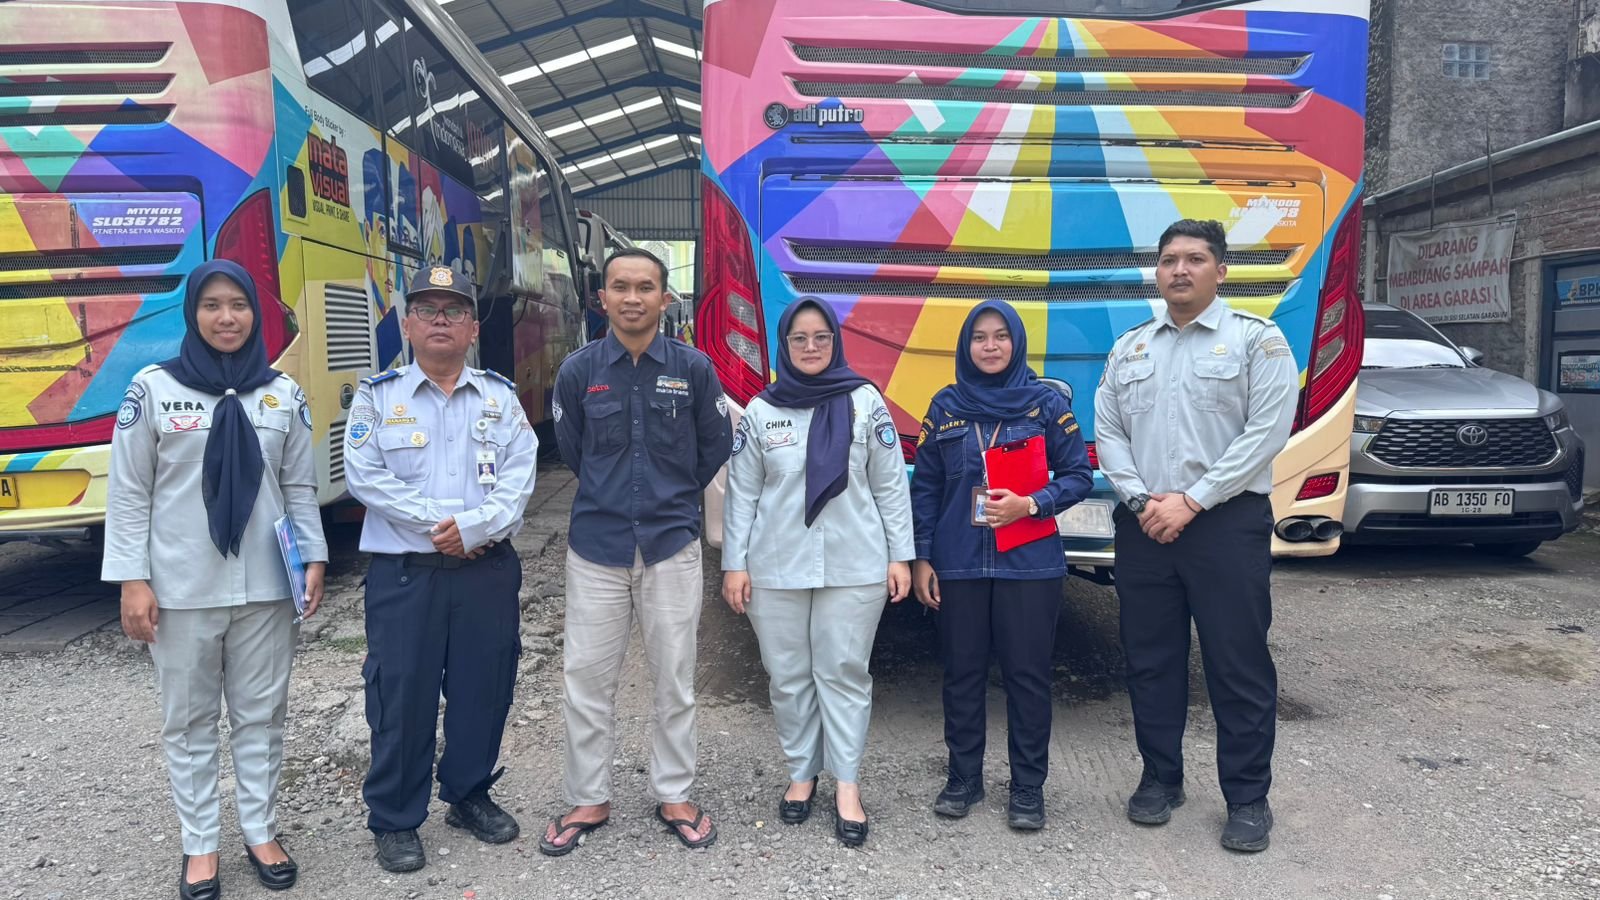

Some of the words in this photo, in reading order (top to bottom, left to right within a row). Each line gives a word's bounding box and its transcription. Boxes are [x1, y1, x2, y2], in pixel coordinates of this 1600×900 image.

[314, 110, 325, 127] Body
[793, 104, 816, 122] adi
[818, 104, 864, 127] putro
[308, 132, 348, 177] mata
[310, 165, 350, 207] visual
[126, 207, 182, 215] MTYK018
[92, 216, 183, 227] SL036782
[1417, 236, 1478, 260] DILARANG
[1389, 266, 1451, 288] MEMBUANG
[1454, 257, 1509, 280] SAMPAH
[1400, 296, 1410, 309] DI
[1412, 292, 1441, 310] AREA
[1443, 287, 1491, 307] GARASI
[161, 401, 205, 411] VERA
[765, 419, 792, 430] CHIKA
[2, 479, 12, 496] A
[1433, 493, 1449, 506] AB
[1456, 493, 1487, 506] 1350
[1494, 493, 1510, 506] FO
